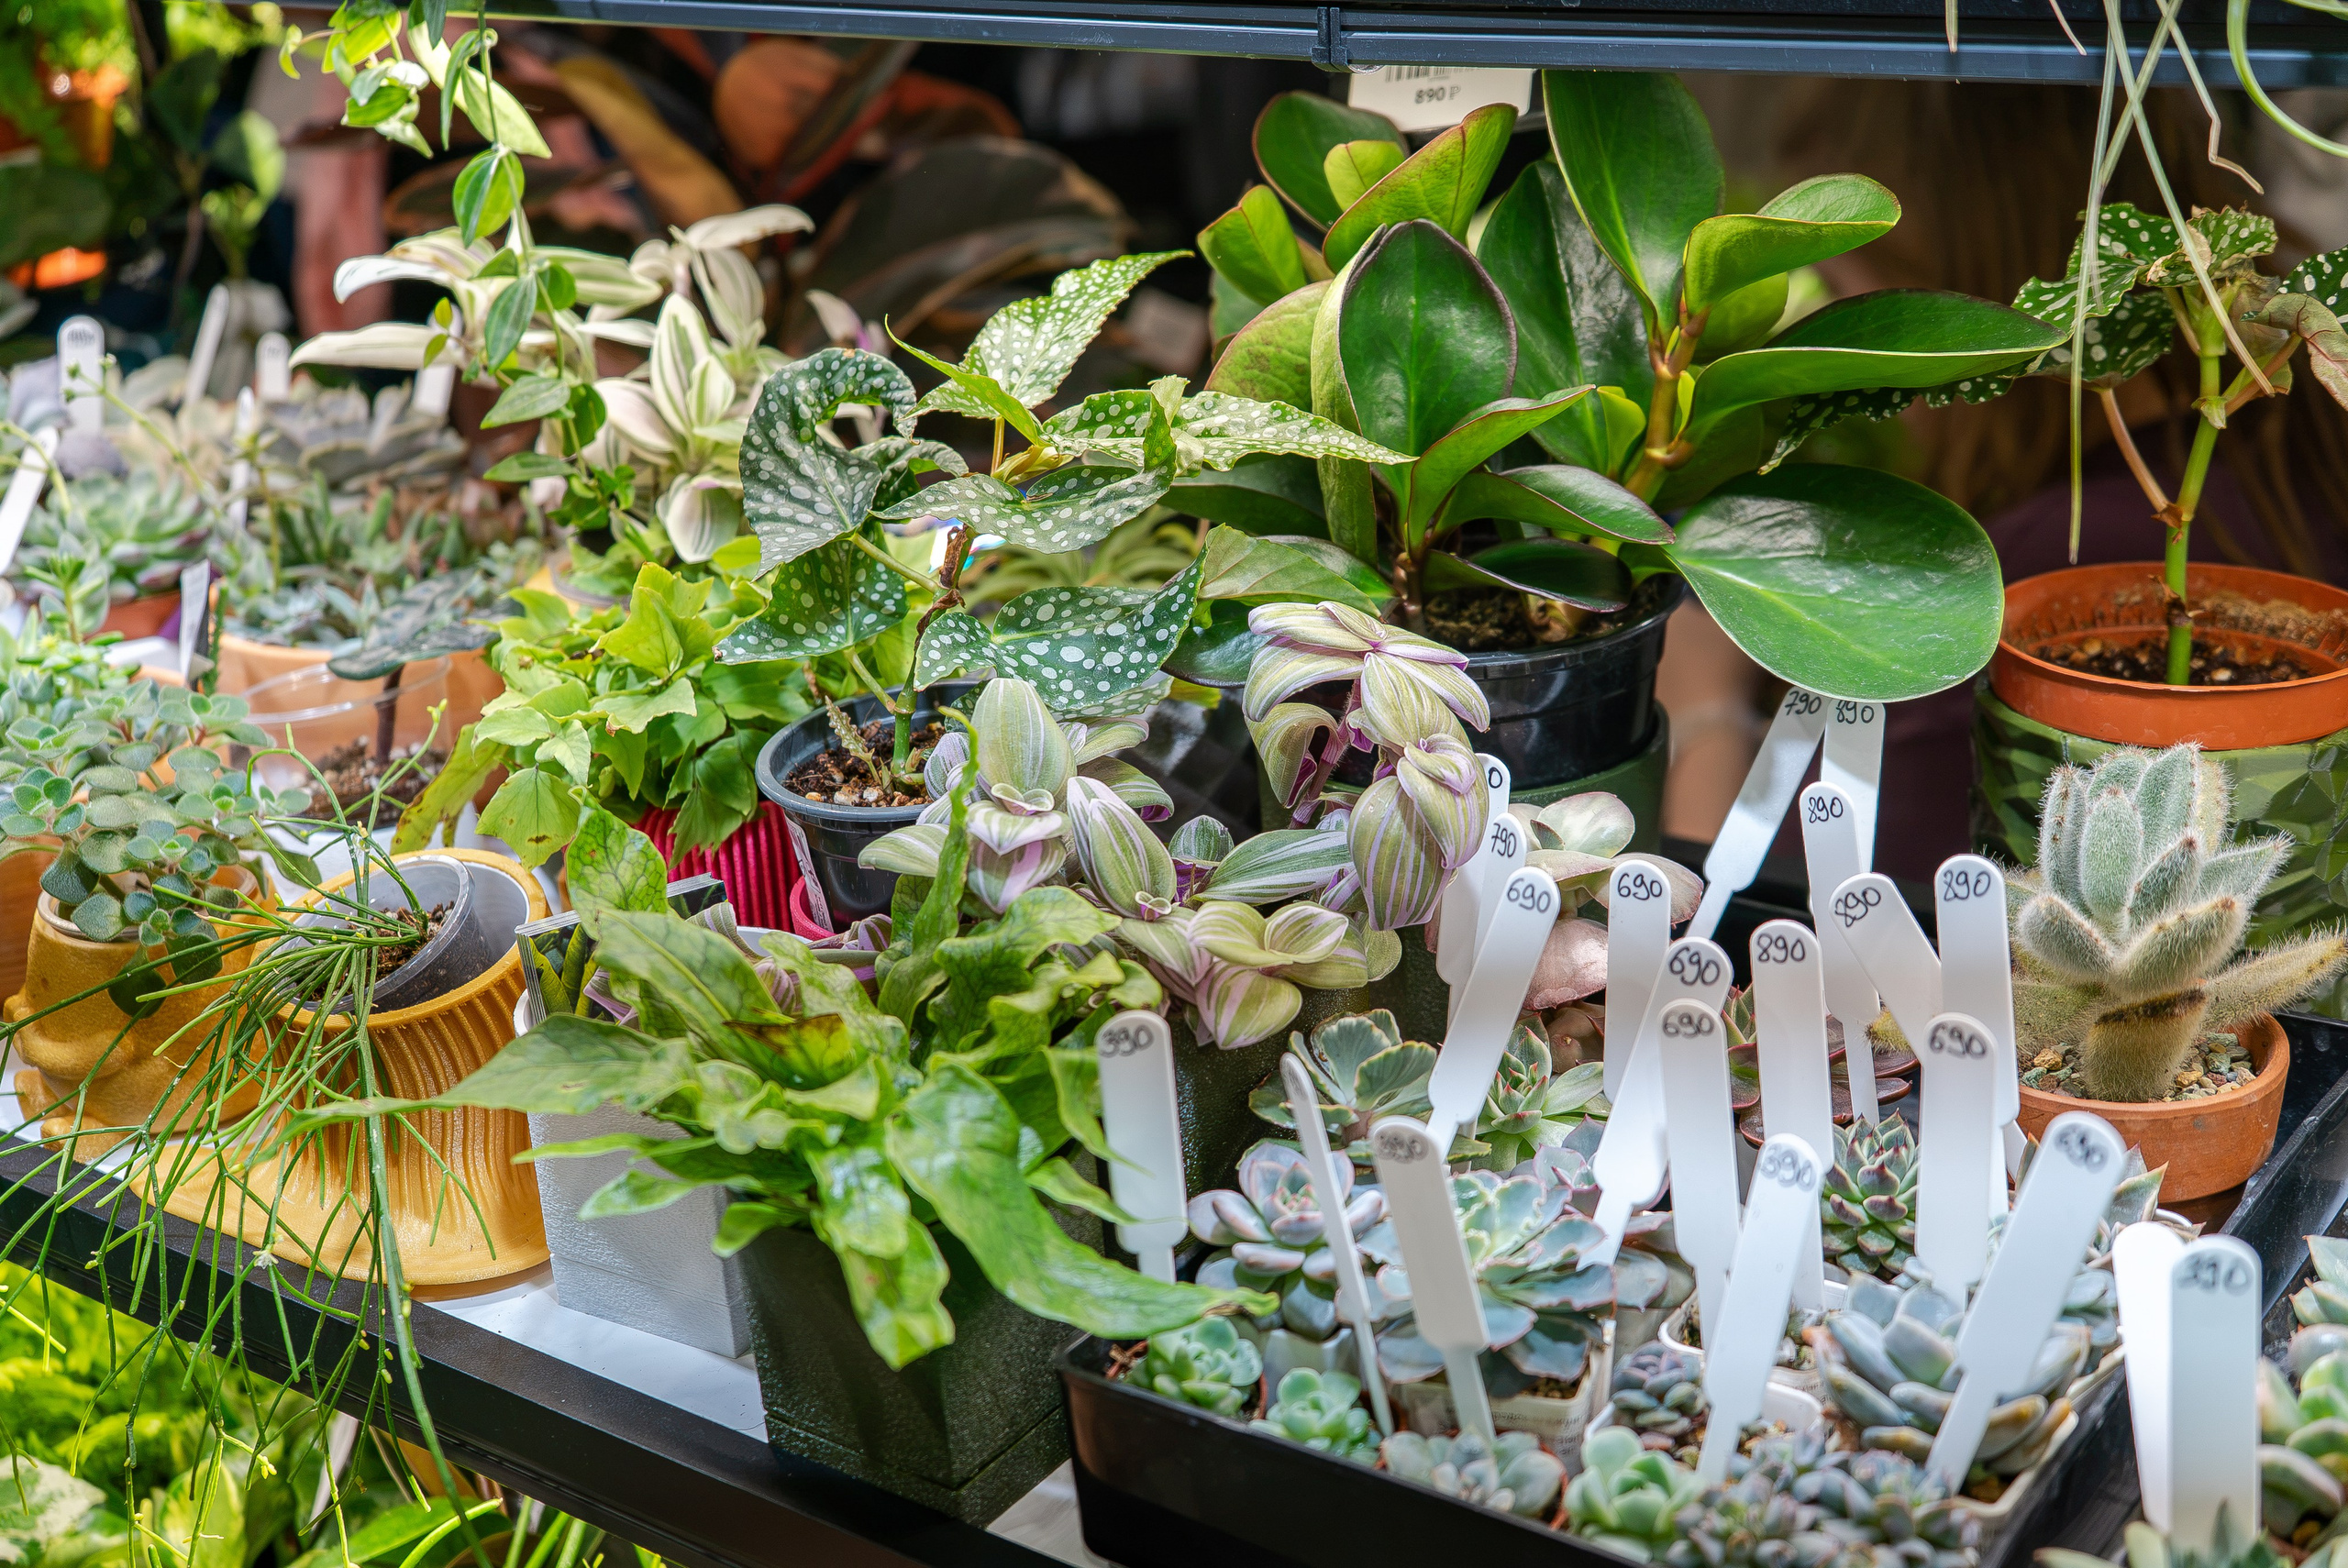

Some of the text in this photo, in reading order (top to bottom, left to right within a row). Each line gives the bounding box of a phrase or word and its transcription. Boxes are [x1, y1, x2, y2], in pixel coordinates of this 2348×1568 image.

[1414, 87, 1445, 104] 890
[1784, 690, 1822, 715] 790
[1835, 700, 1875, 723] 890
[1808, 797, 1844, 823] 890
[1490, 823, 1517, 858] 790
[1507, 878, 1551, 913] 690
[1617, 873, 1662, 900] 690
[1943, 869, 1991, 902] 890
[1834, 887, 1881, 928] 890
[1756, 933, 1806, 964] 890
[1668, 946, 1721, 986] 690
[1101, 1024, 1154, 1058] 390
[1663, 1012, 1714, 1038] 690
[1929, 1021, 1988, 1059] 690
